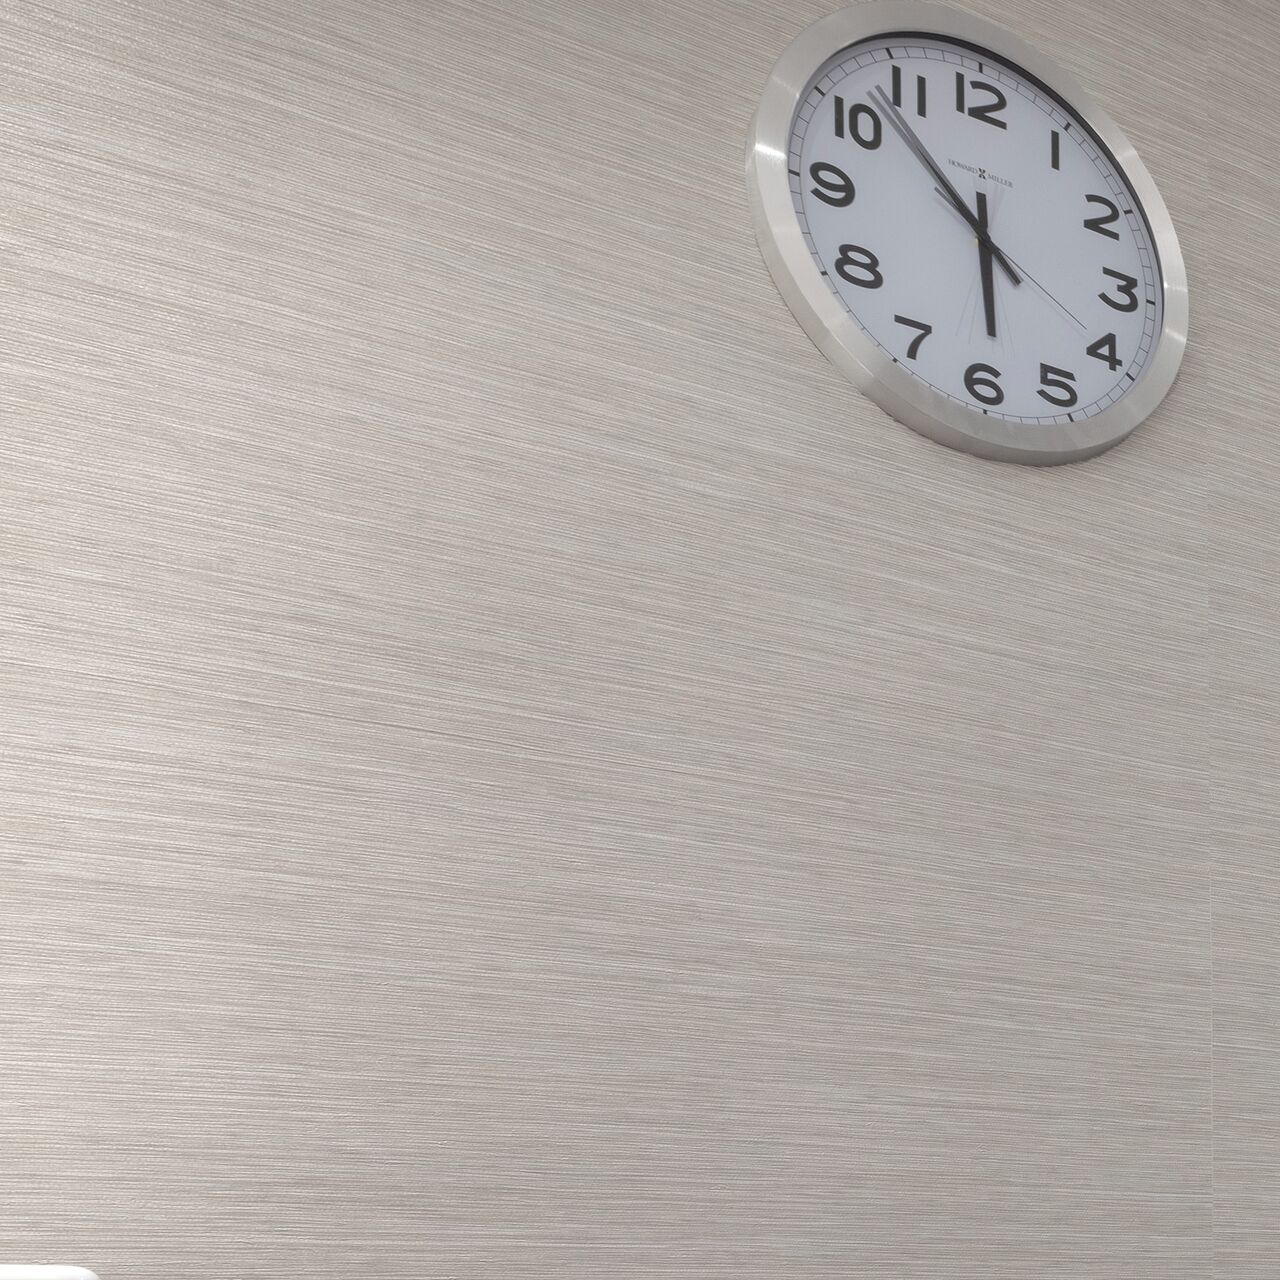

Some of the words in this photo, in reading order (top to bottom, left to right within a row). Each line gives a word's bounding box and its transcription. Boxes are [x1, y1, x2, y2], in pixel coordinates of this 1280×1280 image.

[892, 65, 927, 118] 11
[956, 72, 1007, 130] 12
[834, 95, 882, 150] 10
[1050, 130, 1060, 171] 1
[809, 161, 856, 207] 9
[1083, 194, 1120, 241] 2
[834, 244, 884, 290] 8
[1098, 266, 1138, 313] 3
[894, 314, 932, 360] 7
[1086, 332, 1123, 372] 4
[964, 362, 1005, 406] 6
[1036, 362, 1078, 408] 5
